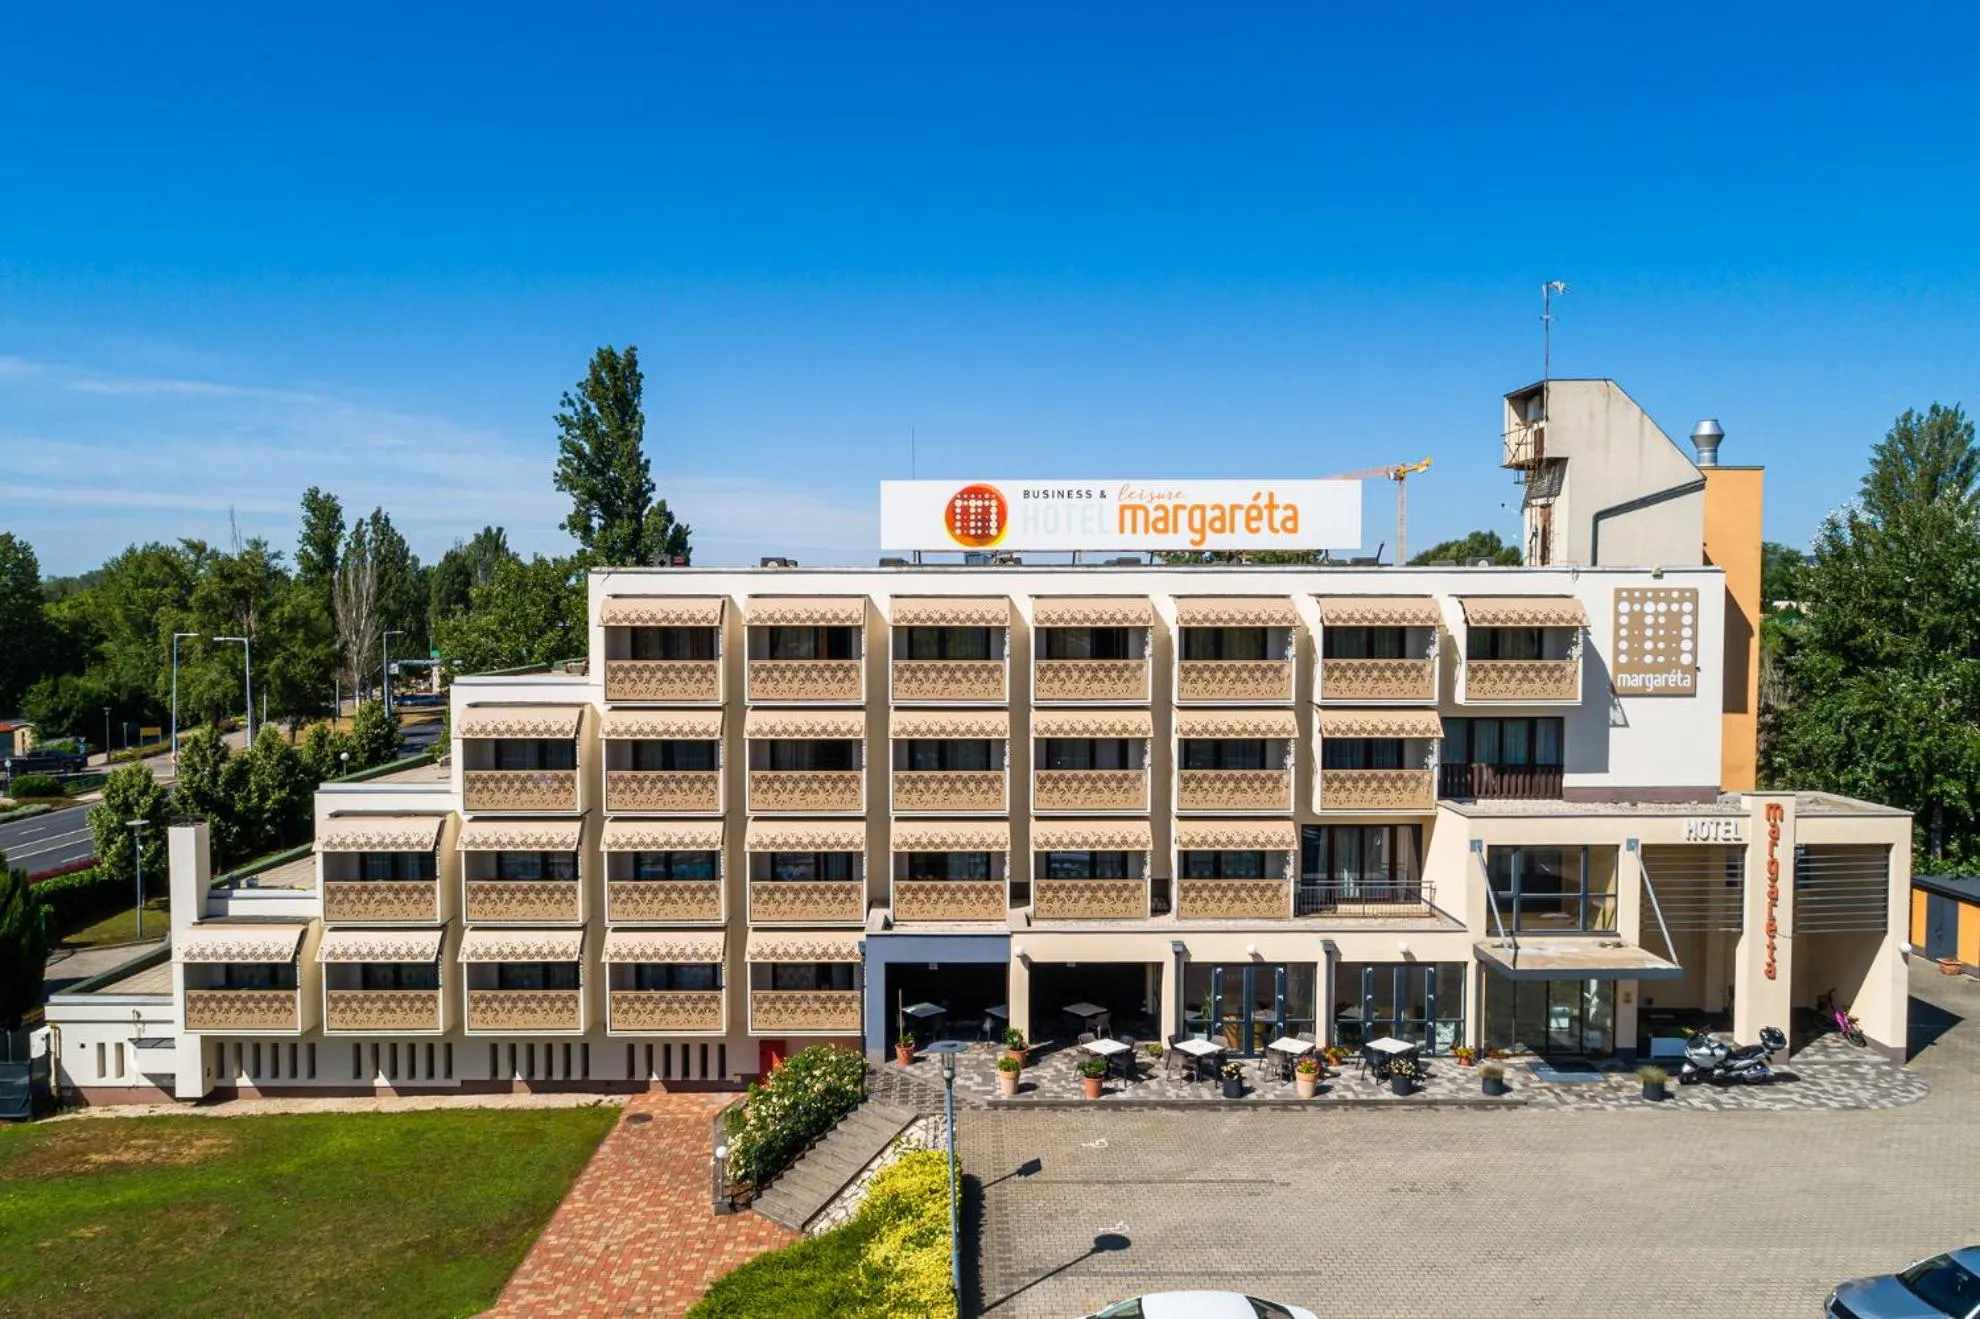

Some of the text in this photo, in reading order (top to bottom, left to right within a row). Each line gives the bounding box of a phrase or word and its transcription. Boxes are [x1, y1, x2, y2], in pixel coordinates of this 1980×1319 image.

[1023, 490, 1093, 499] BUSINESS
[1099, 490, 1107, 499] &
[1022, 491, 1299, 547] HOTEL margaréta
[1617, 669, 1691, 692] margaréta
[1685, 820, 1742, 841] HOTEL
